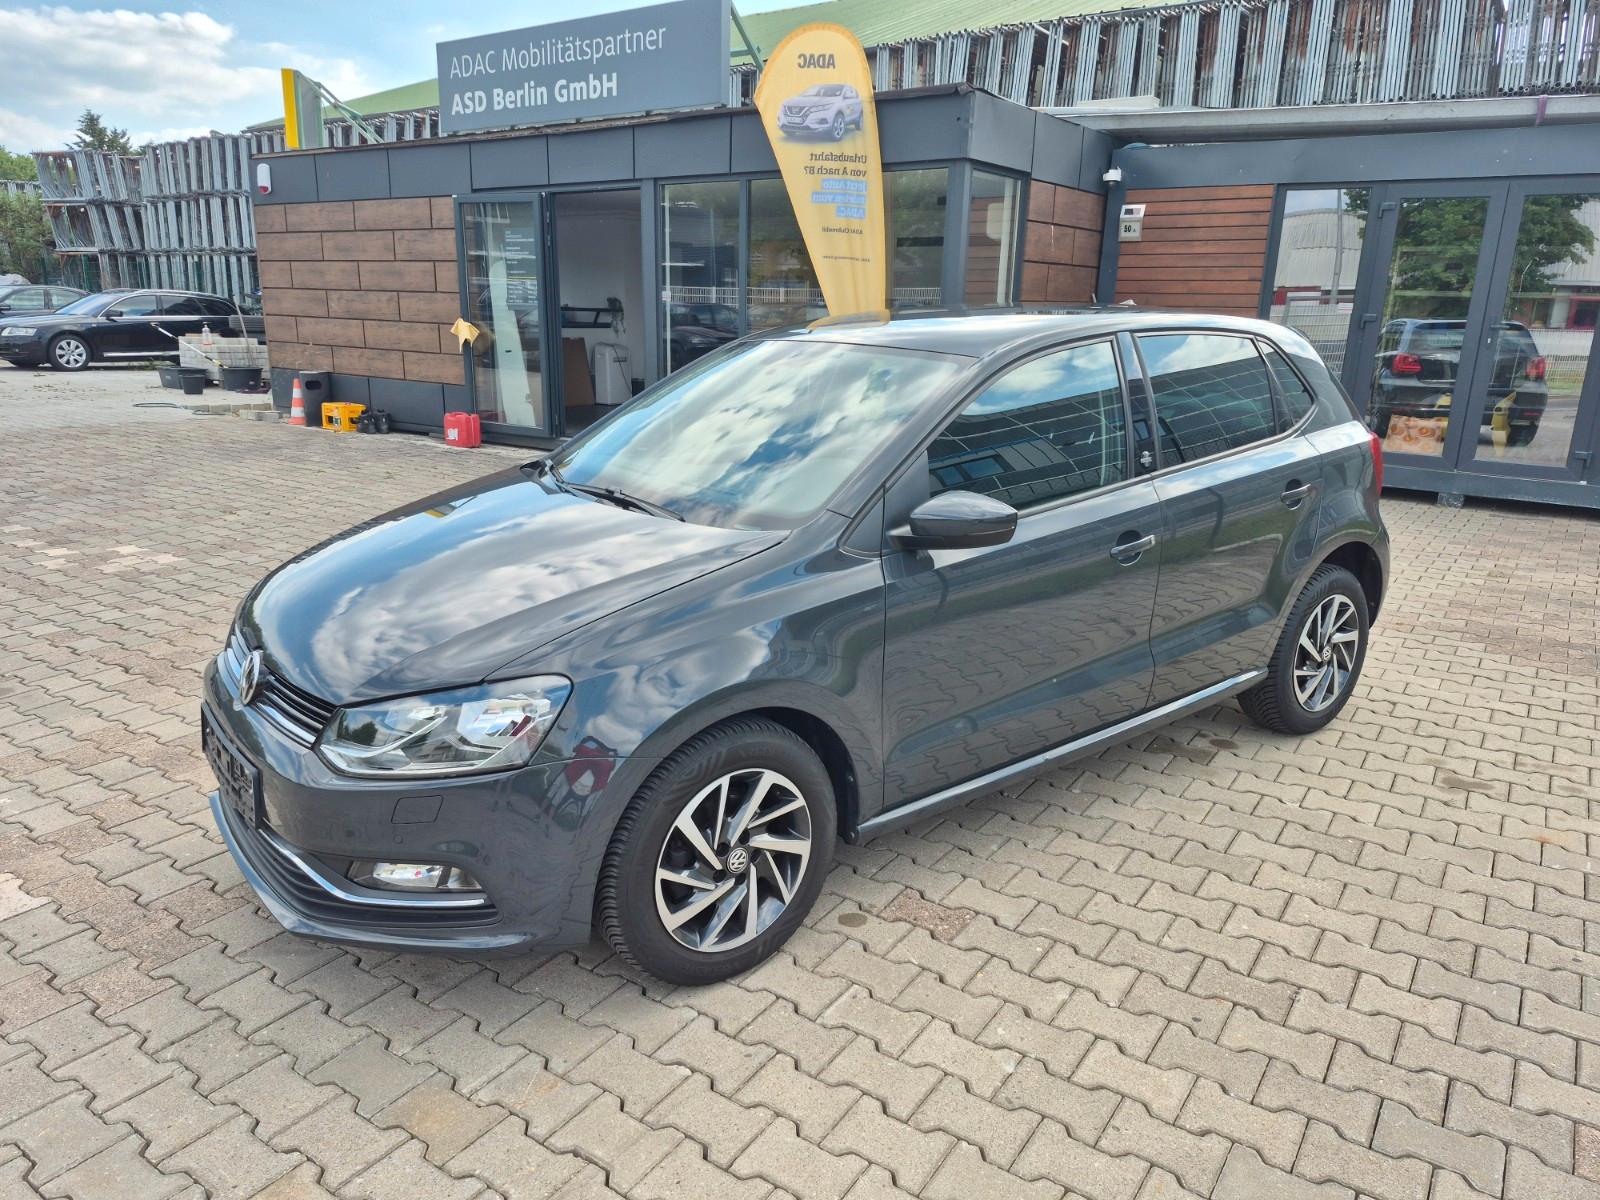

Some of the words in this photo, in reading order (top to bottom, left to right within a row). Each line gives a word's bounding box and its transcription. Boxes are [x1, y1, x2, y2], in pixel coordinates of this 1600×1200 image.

[450, 50, 496, 79] ADAC
[502, 27, 666, 72] Mobilitätspartner
[451, 90, 487, 116] ASD
[493, 78, 548, 110] Berlin
[554, 72, 618, 103] GmbH
